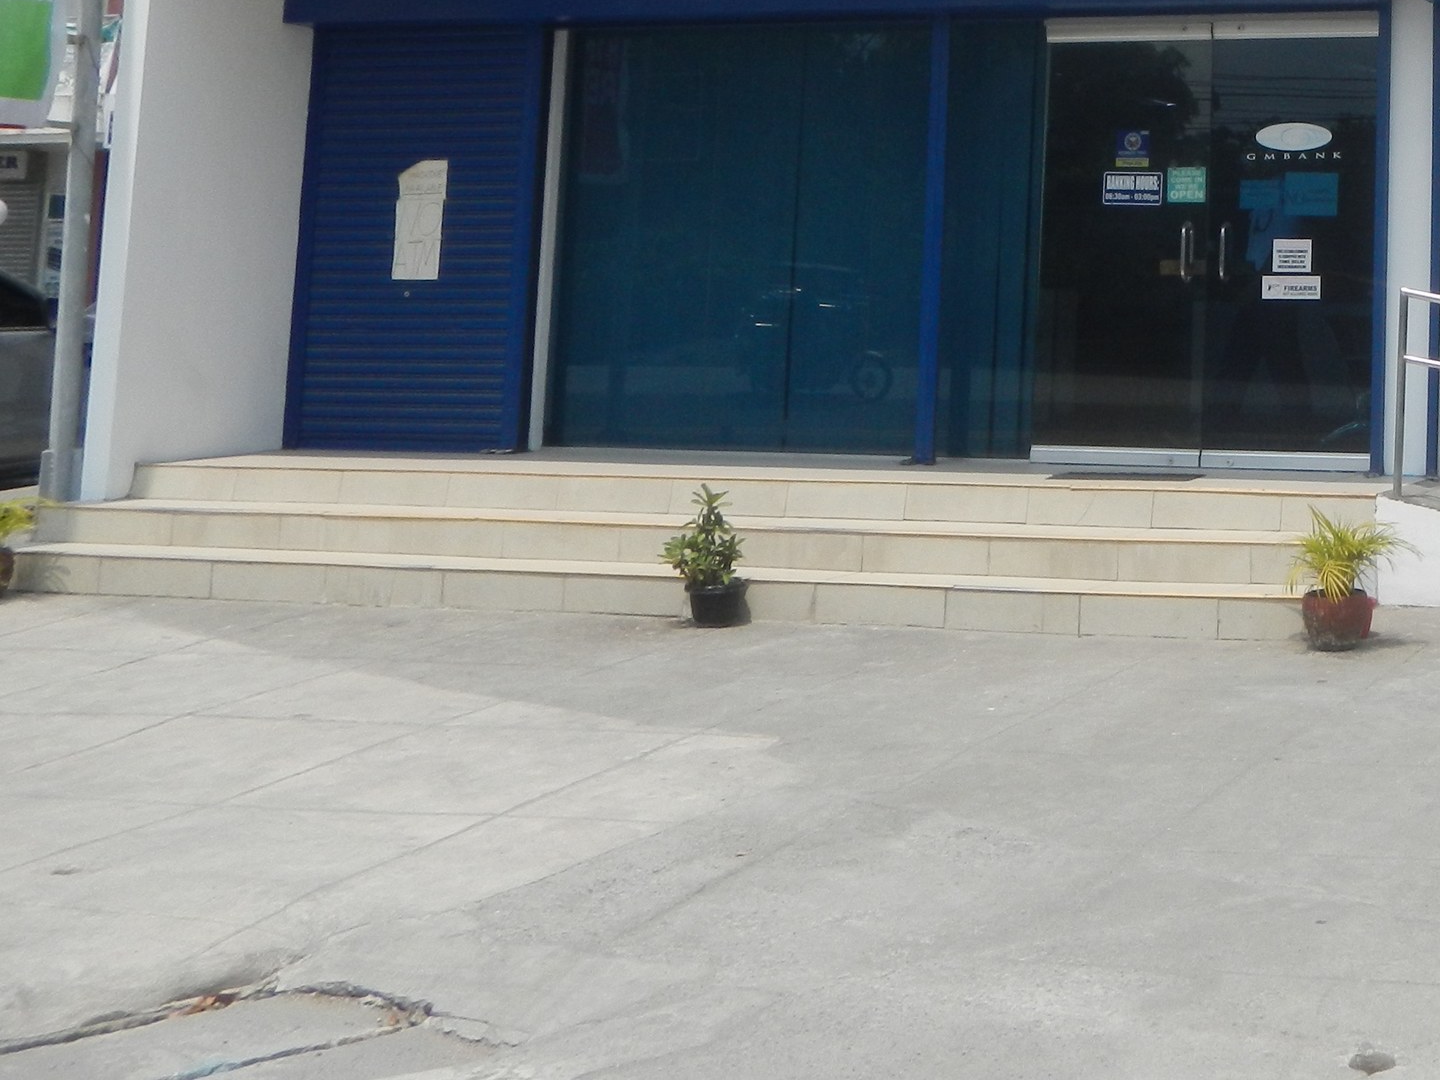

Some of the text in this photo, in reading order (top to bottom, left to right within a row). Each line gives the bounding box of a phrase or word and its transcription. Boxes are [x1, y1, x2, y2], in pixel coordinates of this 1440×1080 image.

[1246, 151, 1342, 161] GMBANK
[1106, 175, 1135, 190] BANKING
[1170, 190, 1203, 199] OPEN
